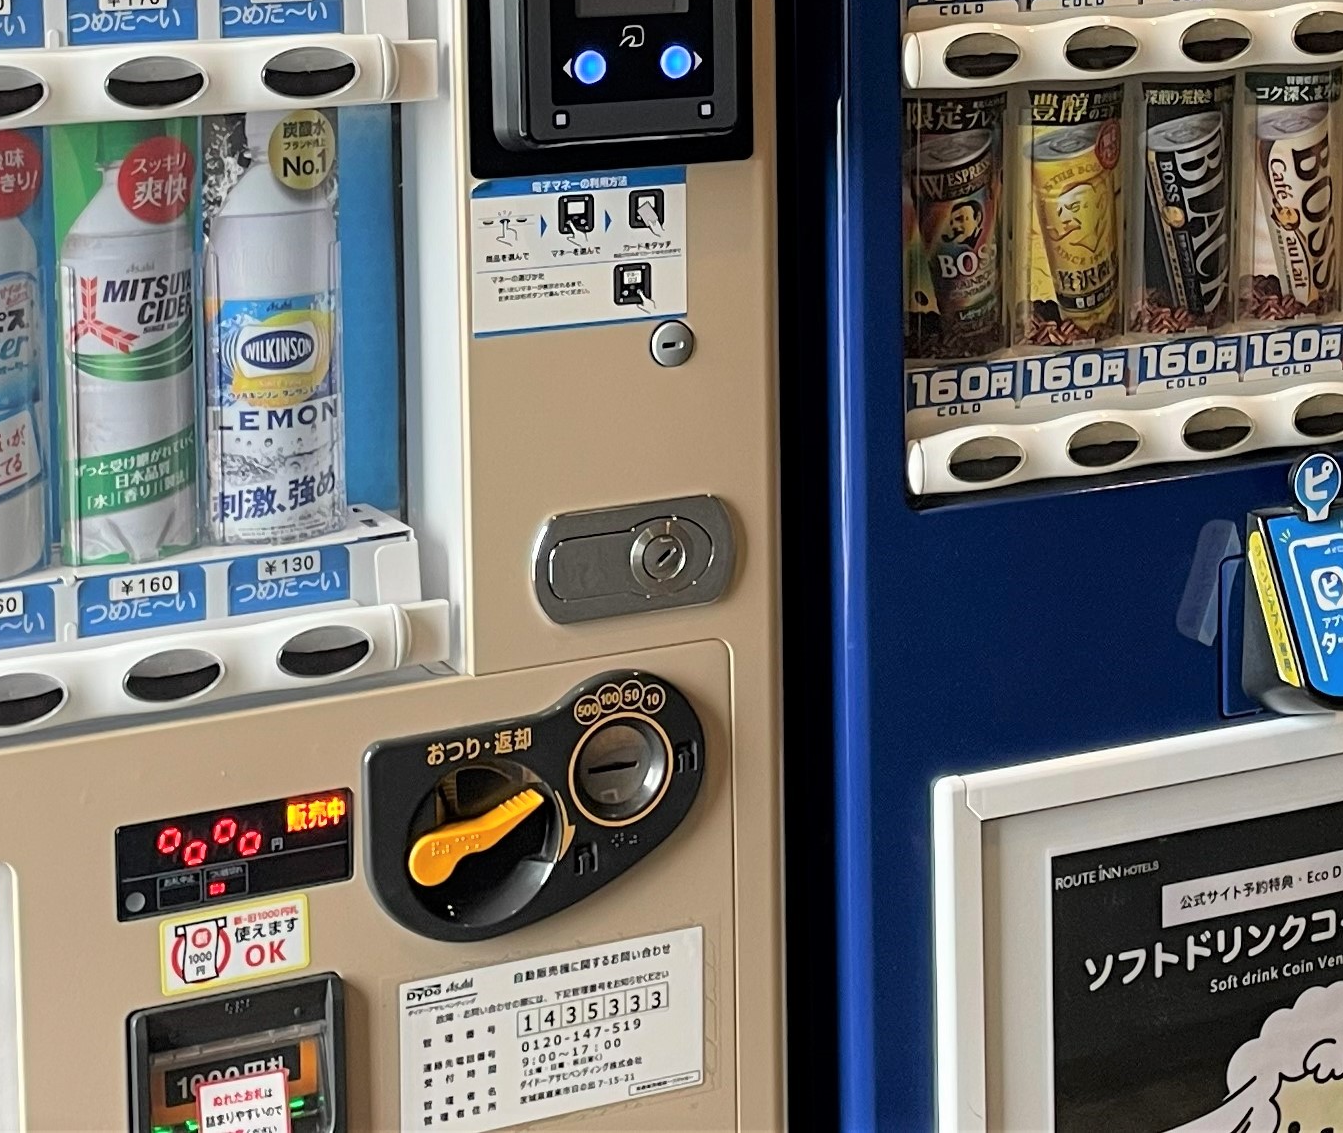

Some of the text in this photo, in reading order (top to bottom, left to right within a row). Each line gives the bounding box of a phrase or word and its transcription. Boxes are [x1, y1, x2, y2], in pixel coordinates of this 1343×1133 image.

[282, 118, 327, 139] 炭酸水
[130, 152, 188, 177] スッキリ
[282, 149, 328, 177] No.1
[131, 176, 188, 209] 爽快
[531, 175, 628, 193] 電子マネーの利用方法
[102, 272, 193, 305] MITSUYA
[136, 293, 193, 325] CIDER
[241, 337, 314, 363] WILKINSON
[1026, 353, 1125, 392] 160円
[1050, 390, 1094, 403] COLD
[216, 396, 338, 433] LEMON
[212, 468, 337, 523] 刺激、強め
[264, 554, 315, 575] ¥130
[577, 701, 599, 718] 500
[599, 690, 621, 707] 100
[425, 726, 533, 767] おつり・返却
[286, 795, 346, 833] 販売中
[1054, 869, 1097, 891] ROUTE
[1123, 859, 1160, 878] HOTELS
[1306, 867, 1330, 884] Eco
[234, 916, 299, 943] 使えます
[245, 939, 287, 967] OK
[1210, 974, 1240, 994] Soft
[1242, 966, 1279, 988] drink
[1282, 958, 1315, 979] Coin
[521, 1018, 642, 1053] 0120-147-519
